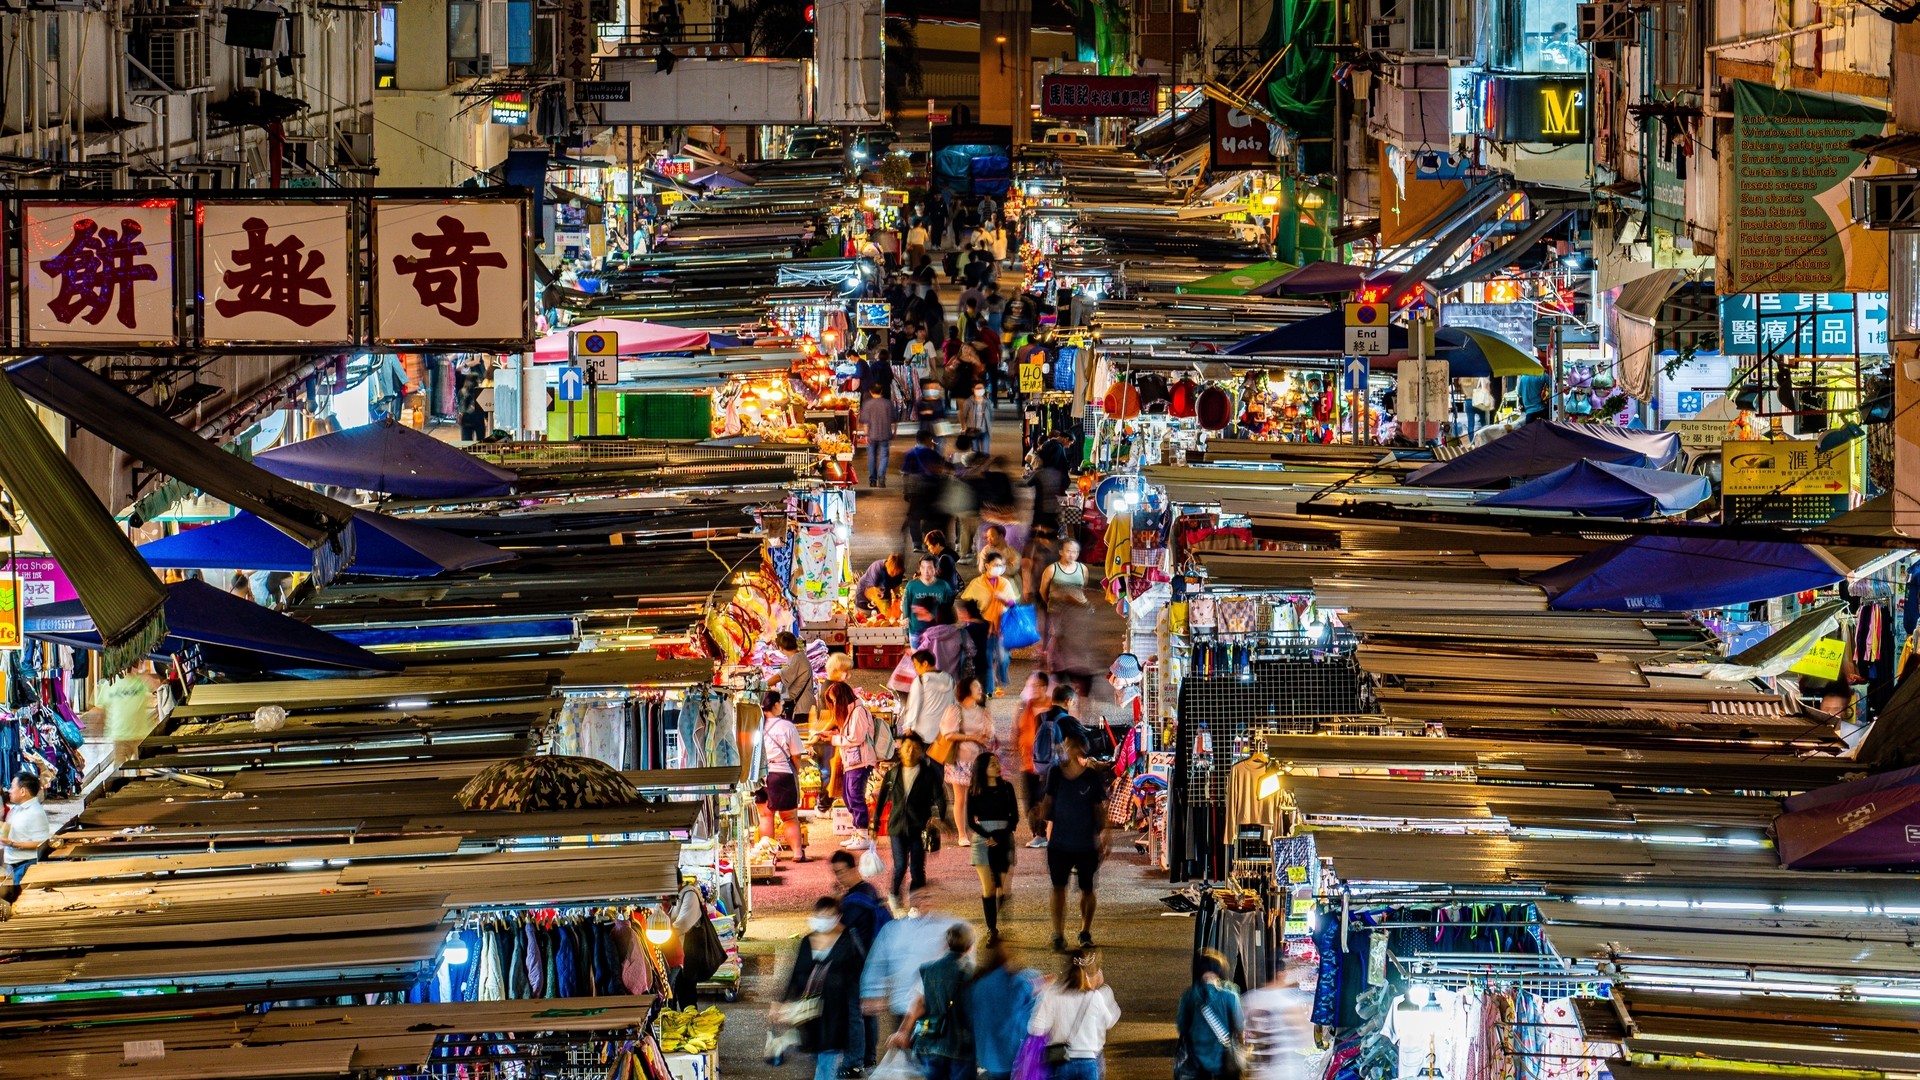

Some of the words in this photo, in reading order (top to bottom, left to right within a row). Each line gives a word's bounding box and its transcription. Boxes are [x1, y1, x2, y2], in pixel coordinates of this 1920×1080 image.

[1742, 128, 1803, 138] Windowsill
[1806, 128, 1855, 138] cushions
[1742, 141, 1785, 153] Balcony
[1788, 141, 1823, 153] safety
[1742, 154, 1806, 165] Smarthome
[1809, 154, 1849, 166] system
[1741, 167, 1788, 177] Curtains
[1791, 167, 1799, 177] &
[1803, 167, 1837, 177] blinds
[1741, 180, 1772, 190] Insect
[1775, 181, 1817, 190] screens
[1741, 193, 1763, 203] Sun
[1765, 193, 1804, 203] shades
[1741, 206, 1765, 216] Sofa
[1769, 206, 1806, 216] fabrics
[1741, 219, 1795, 230] Insulation
[1799, 219, 1827, 230] films
[1741, 233, 1782, 246] Folding
[1785, 234, 1827, 243] screens
[1741, 246, 1781, 256] Interior
[1784, 246, 1827, 256] finishes
[1741, 259, 1773, 270] Fabric
[1776, 259, 1831, 272] partitions
[1794, 272, 1832, 283] fabrics
[1358, 330, 1377, 338] End
[1353, 341, 1381, 352] 終止
[585, 359, 605, 368] End
[1023, 366, 1041, 381] 40
[1681, 423, 1700, 431] Bute
[1701, 423, 1727, 431] Street
[30, 561, 54, 571] Shop
